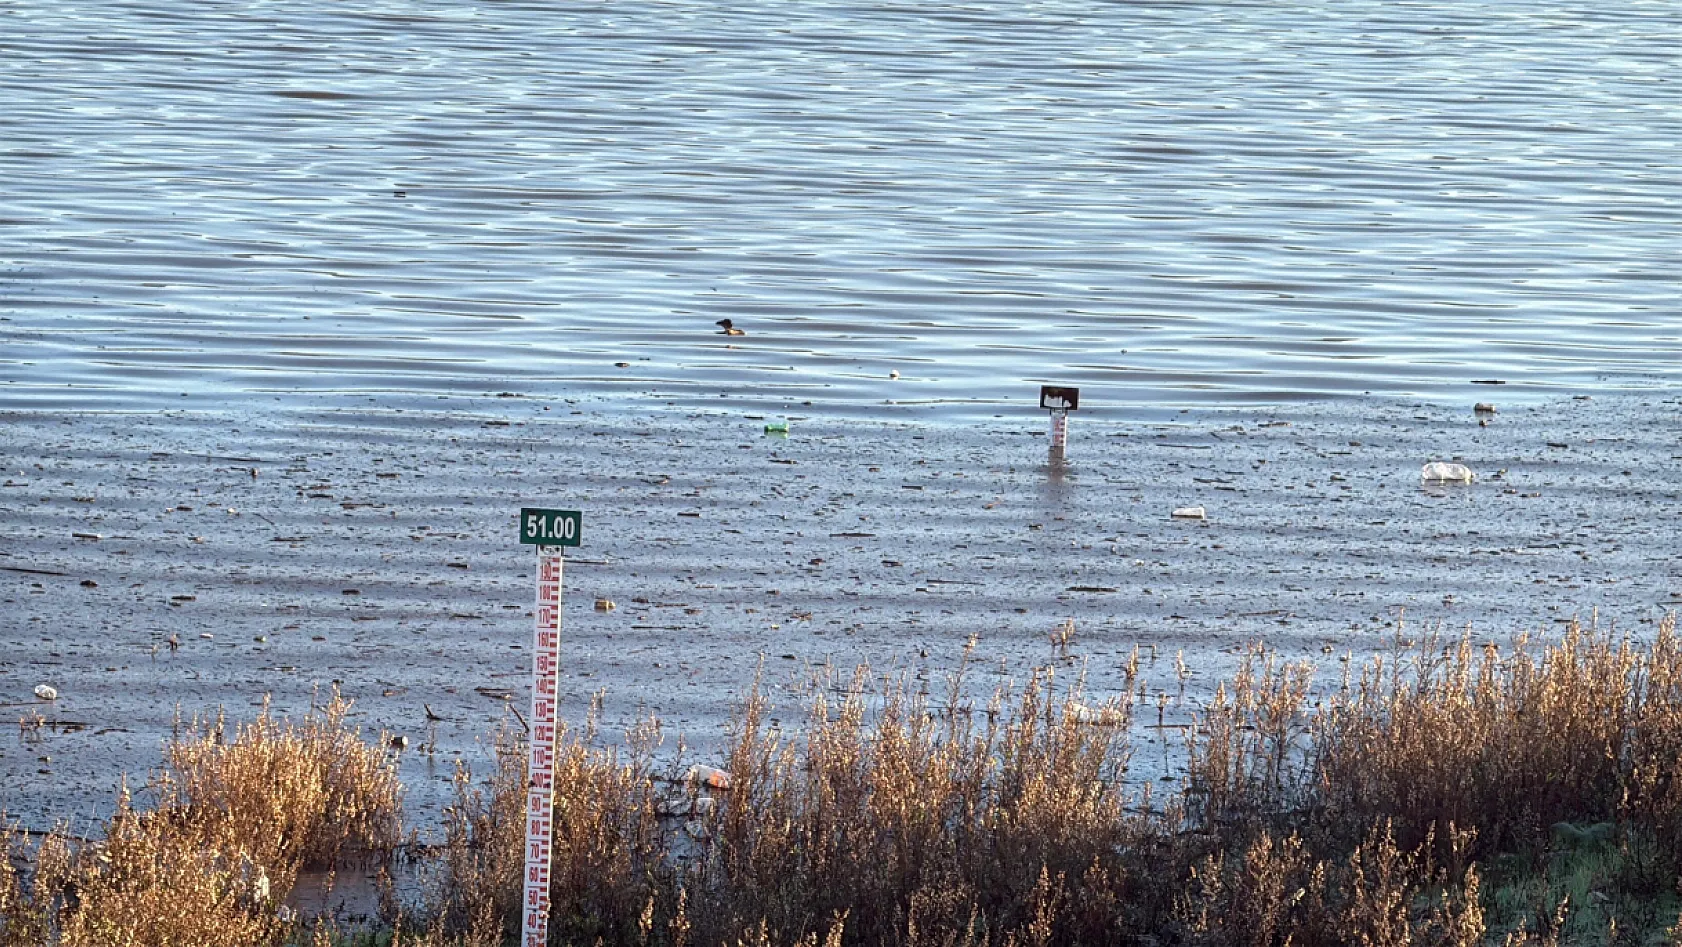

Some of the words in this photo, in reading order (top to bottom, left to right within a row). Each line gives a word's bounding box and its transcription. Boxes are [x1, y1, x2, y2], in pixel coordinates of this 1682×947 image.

[527, 514, 575, 539] 51.00
[540, 585, 550, 600] 180
[539, 609, 550, 624] 170
[531, 797, 540, 812] 90
[531, 820, 540, 835] 80
[530, 843, 539, 859] 70
[529, 866, 538, 882] 60
[528, 890, 538, 906] 50
[528, 914, 537, 929] 40
